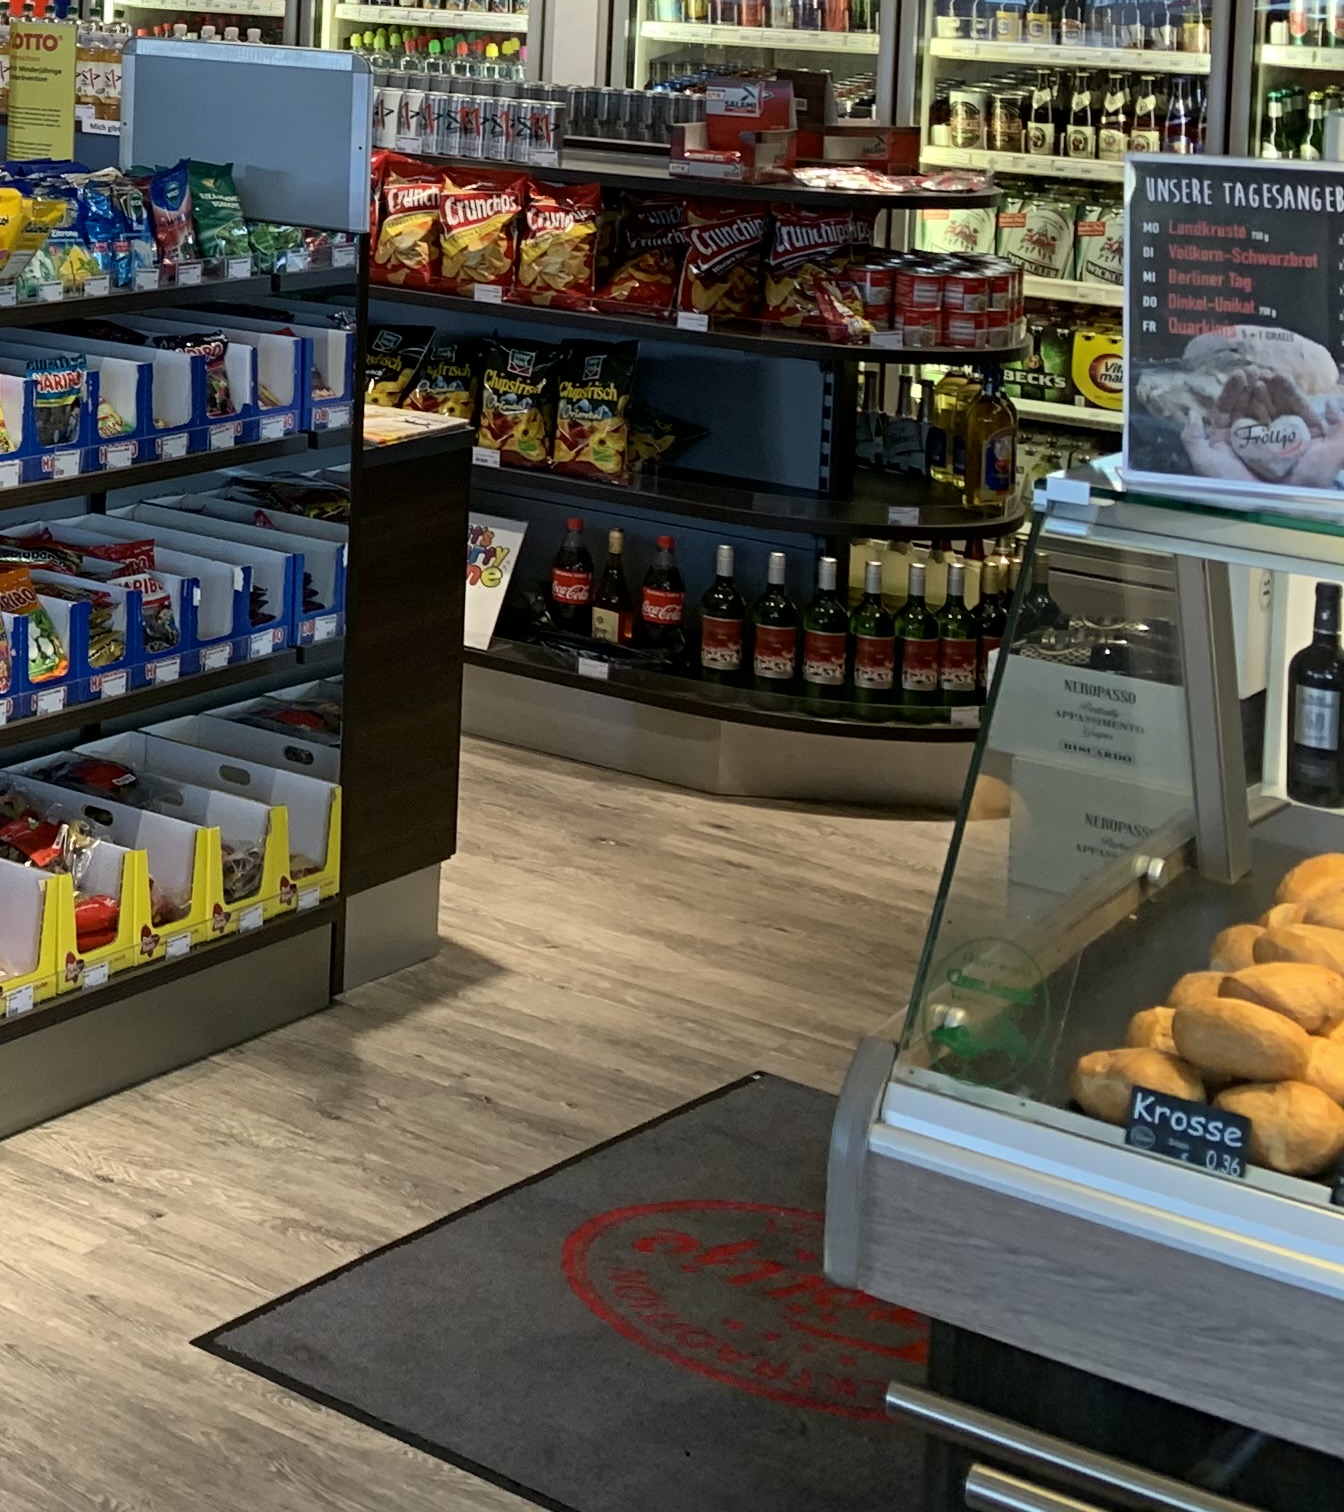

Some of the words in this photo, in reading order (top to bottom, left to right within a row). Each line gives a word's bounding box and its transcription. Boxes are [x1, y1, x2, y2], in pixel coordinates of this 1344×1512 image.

[1146, 177, 1212, 205] UNSERE
[1143, 222, 1159, 233] MO
[1168, 220, 1246, 239] Landkruste
[1143, 246, 1154, 258] DI
[1168, 245, 1318, 269] Vollkorn-Schwarzbrot
[1143, 271, 1156, 283] MI
[1168, 269, 1226, 288] Berliner
[1229, 272, 1252, 292] Tag
[1143, 296, 1158, 308] DO
[1168, 293, 1256, 314] Dinkel-Unikat
[1143, 320, 1157, 333] FR
[35, 369, 86, 394] HARIBO
[1003, 368, 1067, 389] BECK'S
[1065, 679, 1137, 705] NEROPASSO
[1134, 1092, 1243, 1148] Krosse
